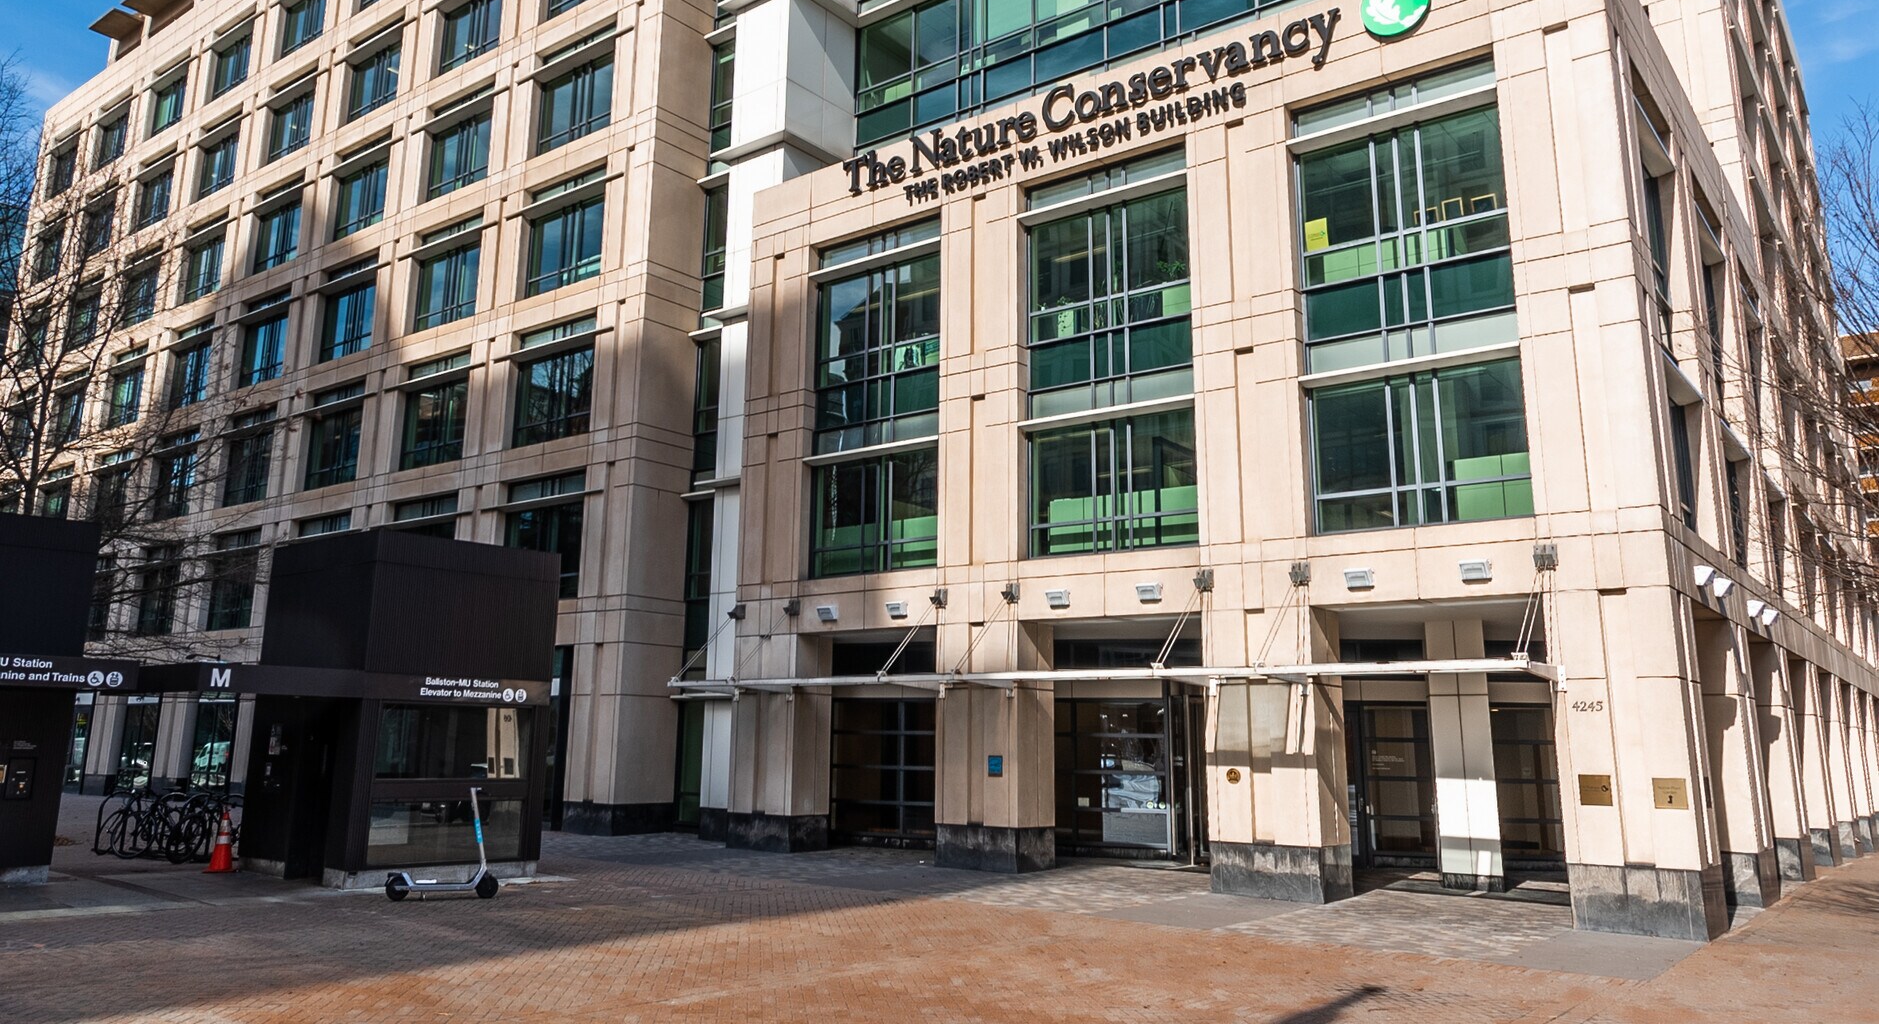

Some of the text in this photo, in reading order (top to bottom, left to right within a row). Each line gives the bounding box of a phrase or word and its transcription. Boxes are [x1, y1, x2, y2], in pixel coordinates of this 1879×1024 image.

[843, 7, 1341, 196] The Nature Conservancy
[903, 82, 1246, 205] THE ROBERT W. WILSON BUILDING
[13, 657, 53, 668] Station
[28, 671, 50, 681] and
[52, 672, 86, 683] Trains
[210, 668, 231, 687] M
[425, 677, 499, 689] Ballston-MU Station
[420, 687, 501, 699] Elevator to Mezzanine
[1572, 700, 1603, 712] 4245
